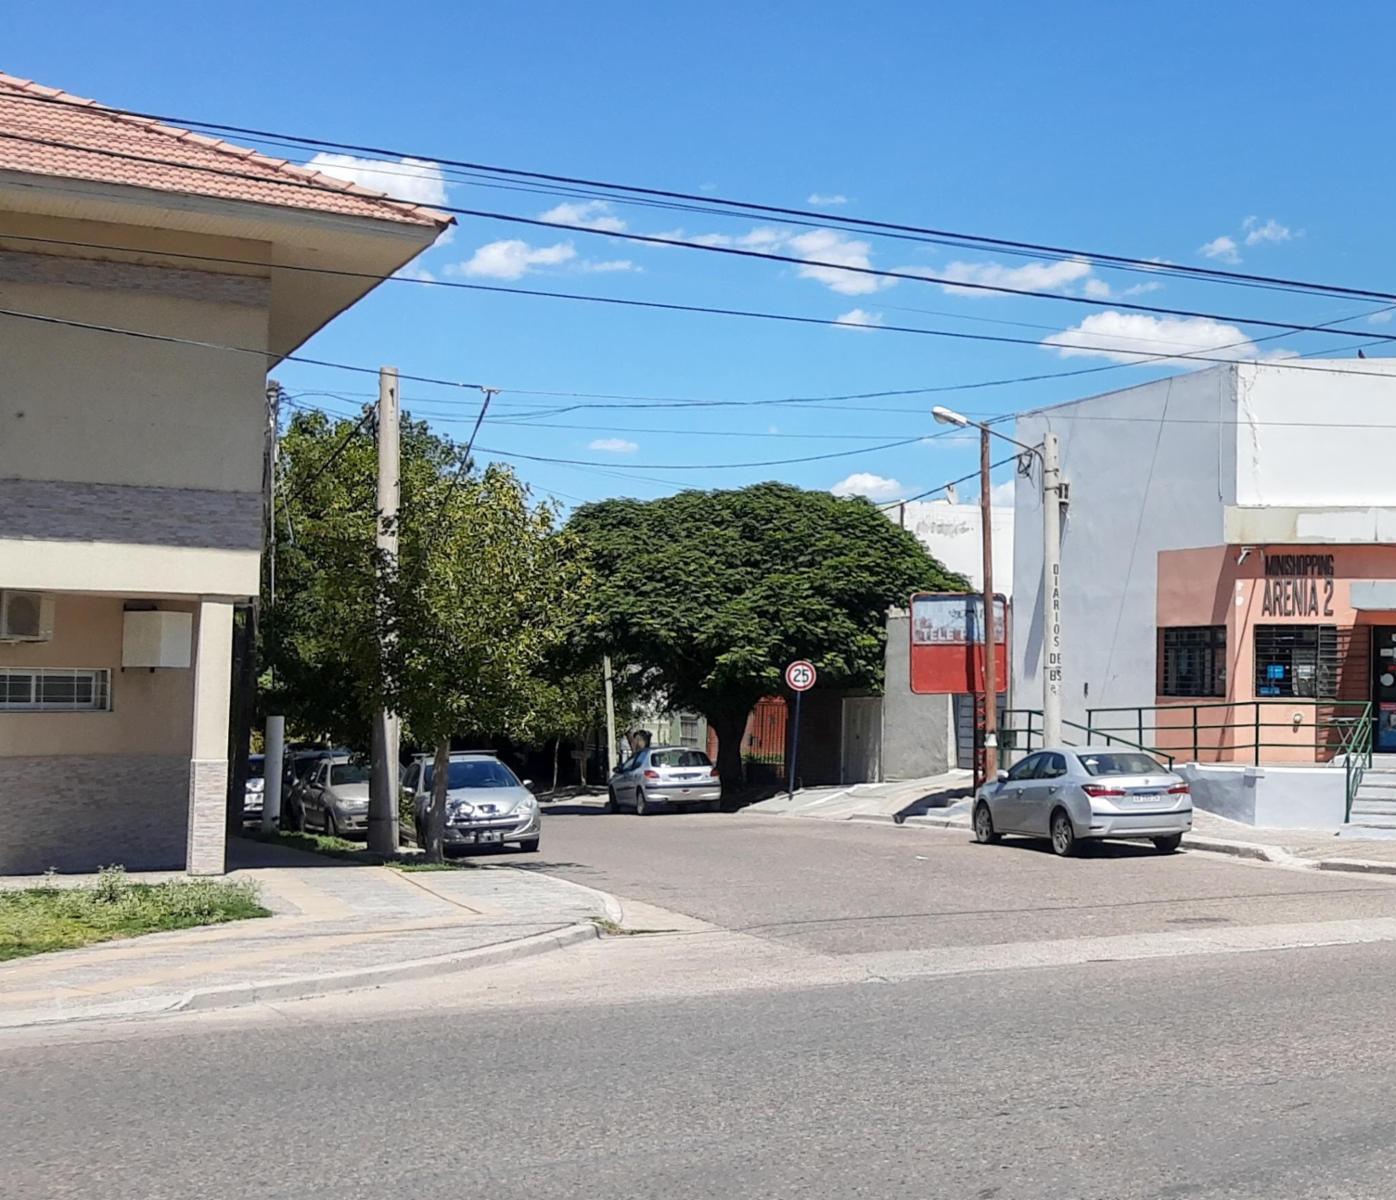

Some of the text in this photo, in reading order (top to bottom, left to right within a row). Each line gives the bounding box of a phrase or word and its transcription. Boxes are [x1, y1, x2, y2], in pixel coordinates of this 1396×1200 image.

[1265, 554, 1335, 576] MINISHOPPING
[1052, 563, 1061, 648] DIARIOS
[1261, 577, 1334, 617] ARENIA 2
[1049, 653, 1062, 665] DE
[793, 668, 809, 683] 25
